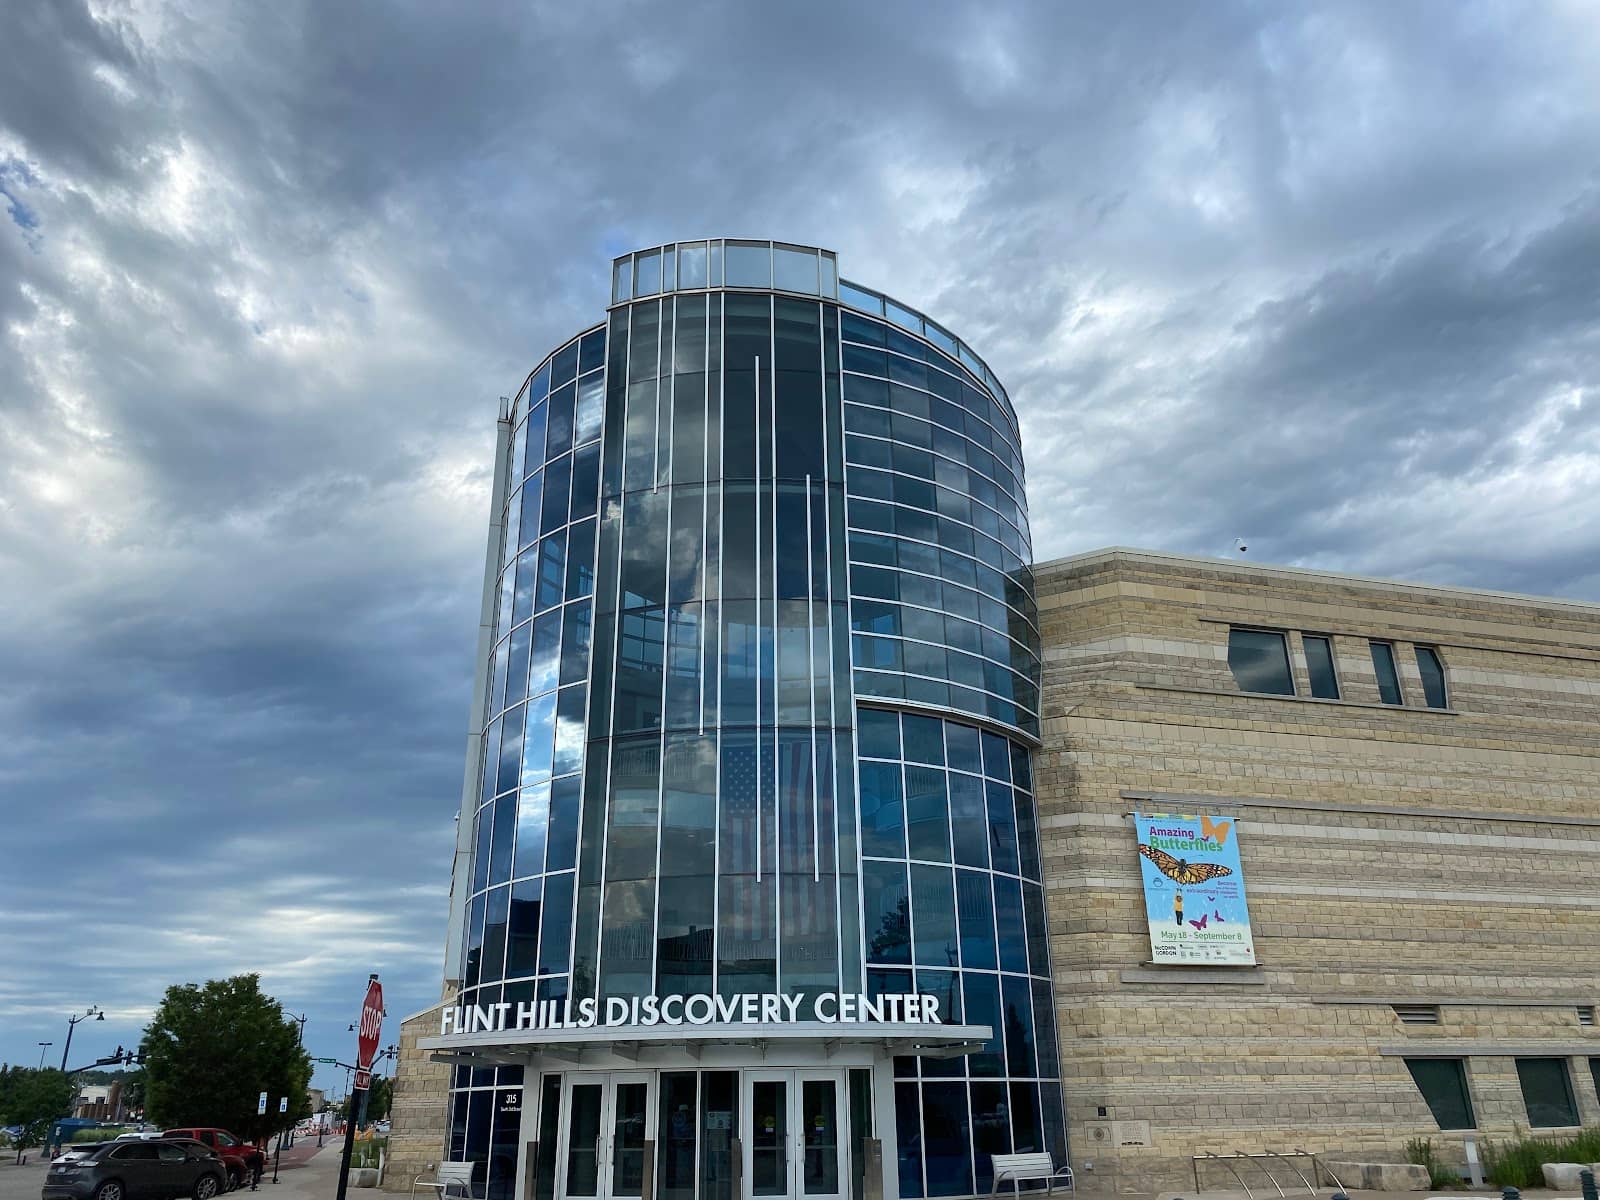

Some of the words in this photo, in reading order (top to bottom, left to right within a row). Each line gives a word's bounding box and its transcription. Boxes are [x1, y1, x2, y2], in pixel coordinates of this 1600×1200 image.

[1149, 826, 1194, 839] Amazing
[1150, 836, 1223, 852] Butterflies
[1161, 931, 1177, 940] May
[1179, 931, 1187, 939] 18
[1193, 931, 1235, 941] September
[1237, 932, 1242, 940] 8
[440, 1003, 512, 1035] FLINT
[516, 997, 596, 1030] HILLS
[605, 993, 805, 1027] DISCOVERY
[814, 992, 942, 1024] CENTER
[361, 1006, 382, 1041] STOP
[505, 1094, 517, 1104] 315
